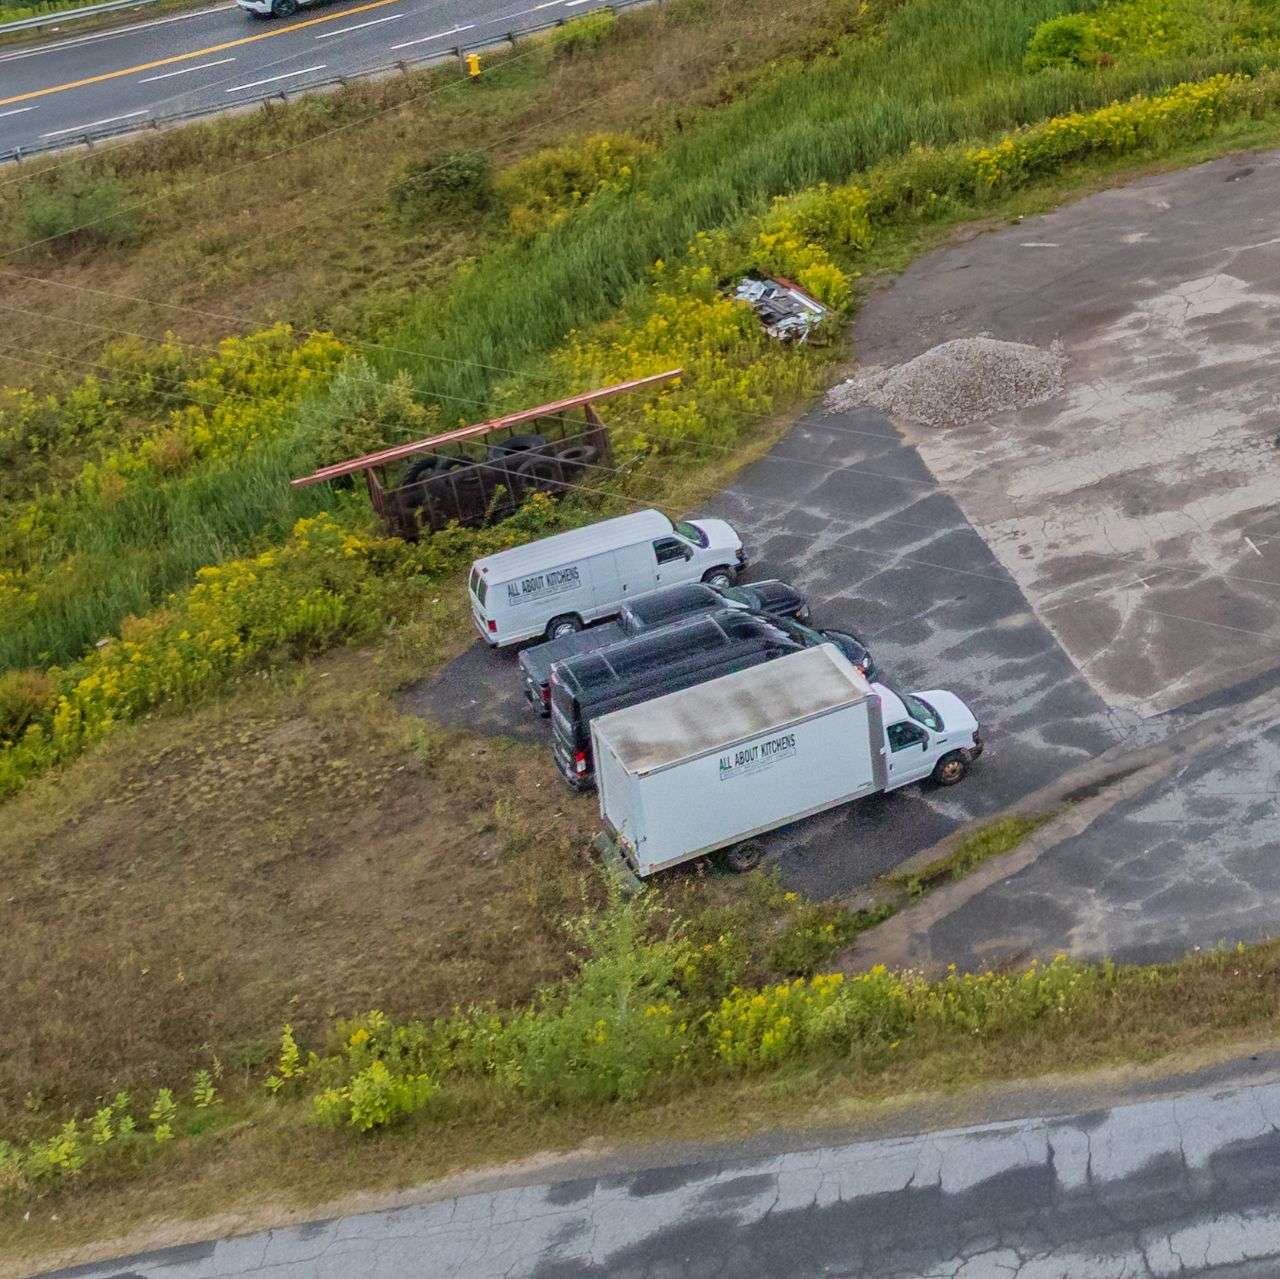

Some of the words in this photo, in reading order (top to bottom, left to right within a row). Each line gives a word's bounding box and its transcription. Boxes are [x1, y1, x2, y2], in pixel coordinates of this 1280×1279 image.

[507, 580, 521, 598] ALL
[521, 575, 544, 594] ABOUT
[544, 566, 580, 587] KITCHENS
[719, 755, 733, 771] ALL
[734, 745, 759, 767] ABOUT
[760, 733, 797, 758] KITCHENS
